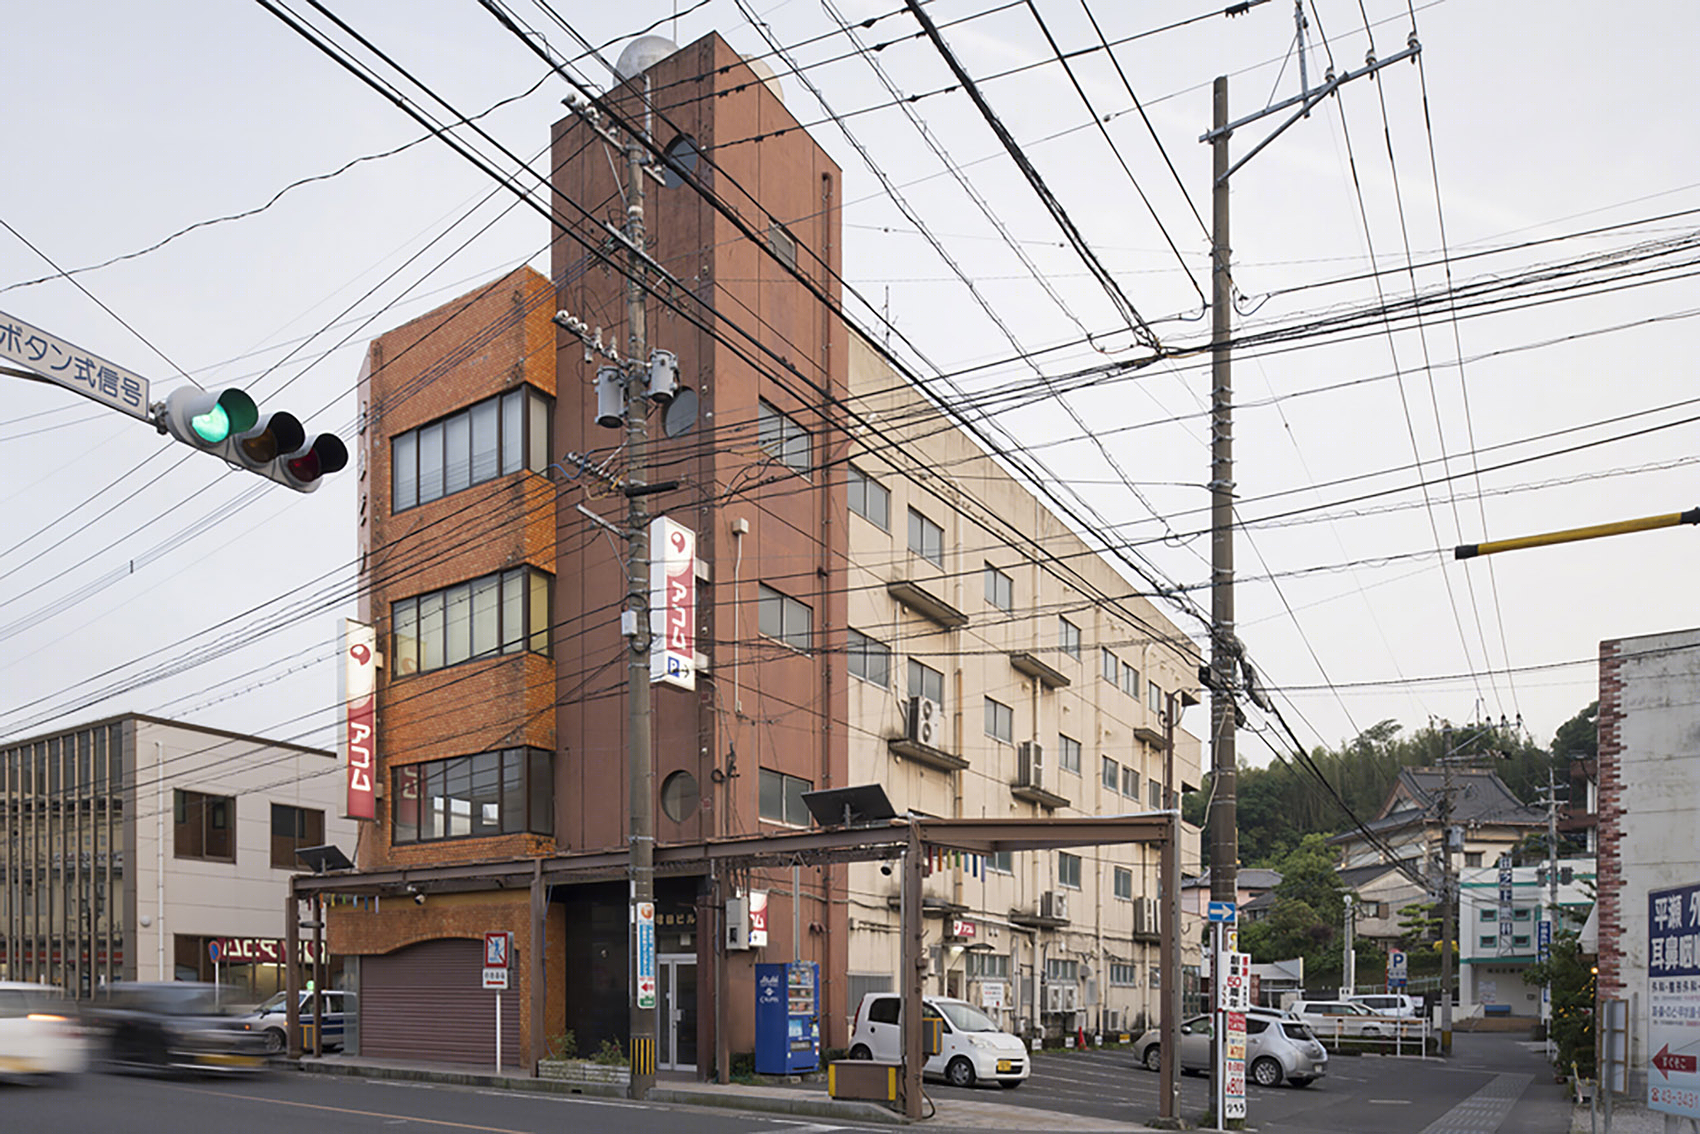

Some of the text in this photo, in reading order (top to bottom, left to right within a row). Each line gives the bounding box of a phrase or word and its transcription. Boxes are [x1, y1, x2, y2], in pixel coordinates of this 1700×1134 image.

[0, 324, 142, 408] ボタン式信号
[671, 581, 687, 651] アコム
[350, 722, 371, 792] アコム
[1393, 953, 1404, 968] P
